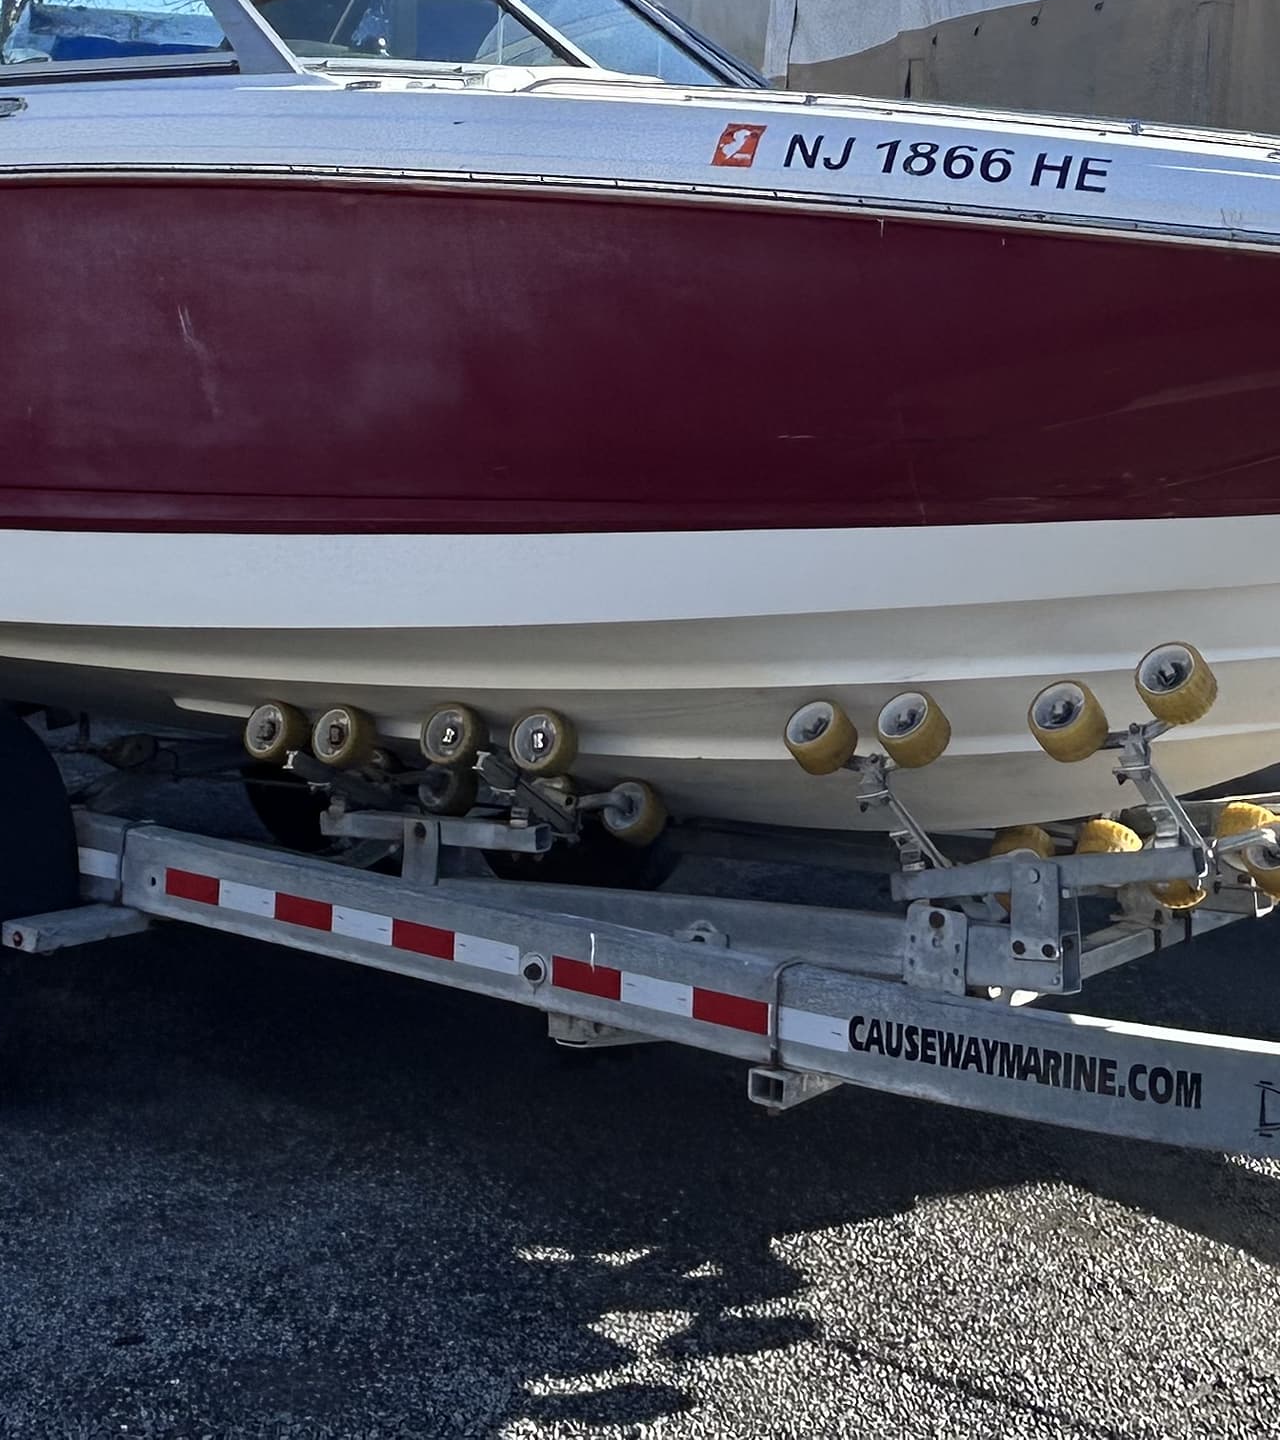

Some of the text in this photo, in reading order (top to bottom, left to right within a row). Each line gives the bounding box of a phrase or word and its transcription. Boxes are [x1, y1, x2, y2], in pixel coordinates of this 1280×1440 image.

[783, 133, 1114, 193] NJ 1866 HE
[847, 1015, 1204, 1110] CAUSEWAYMARINE.COM
